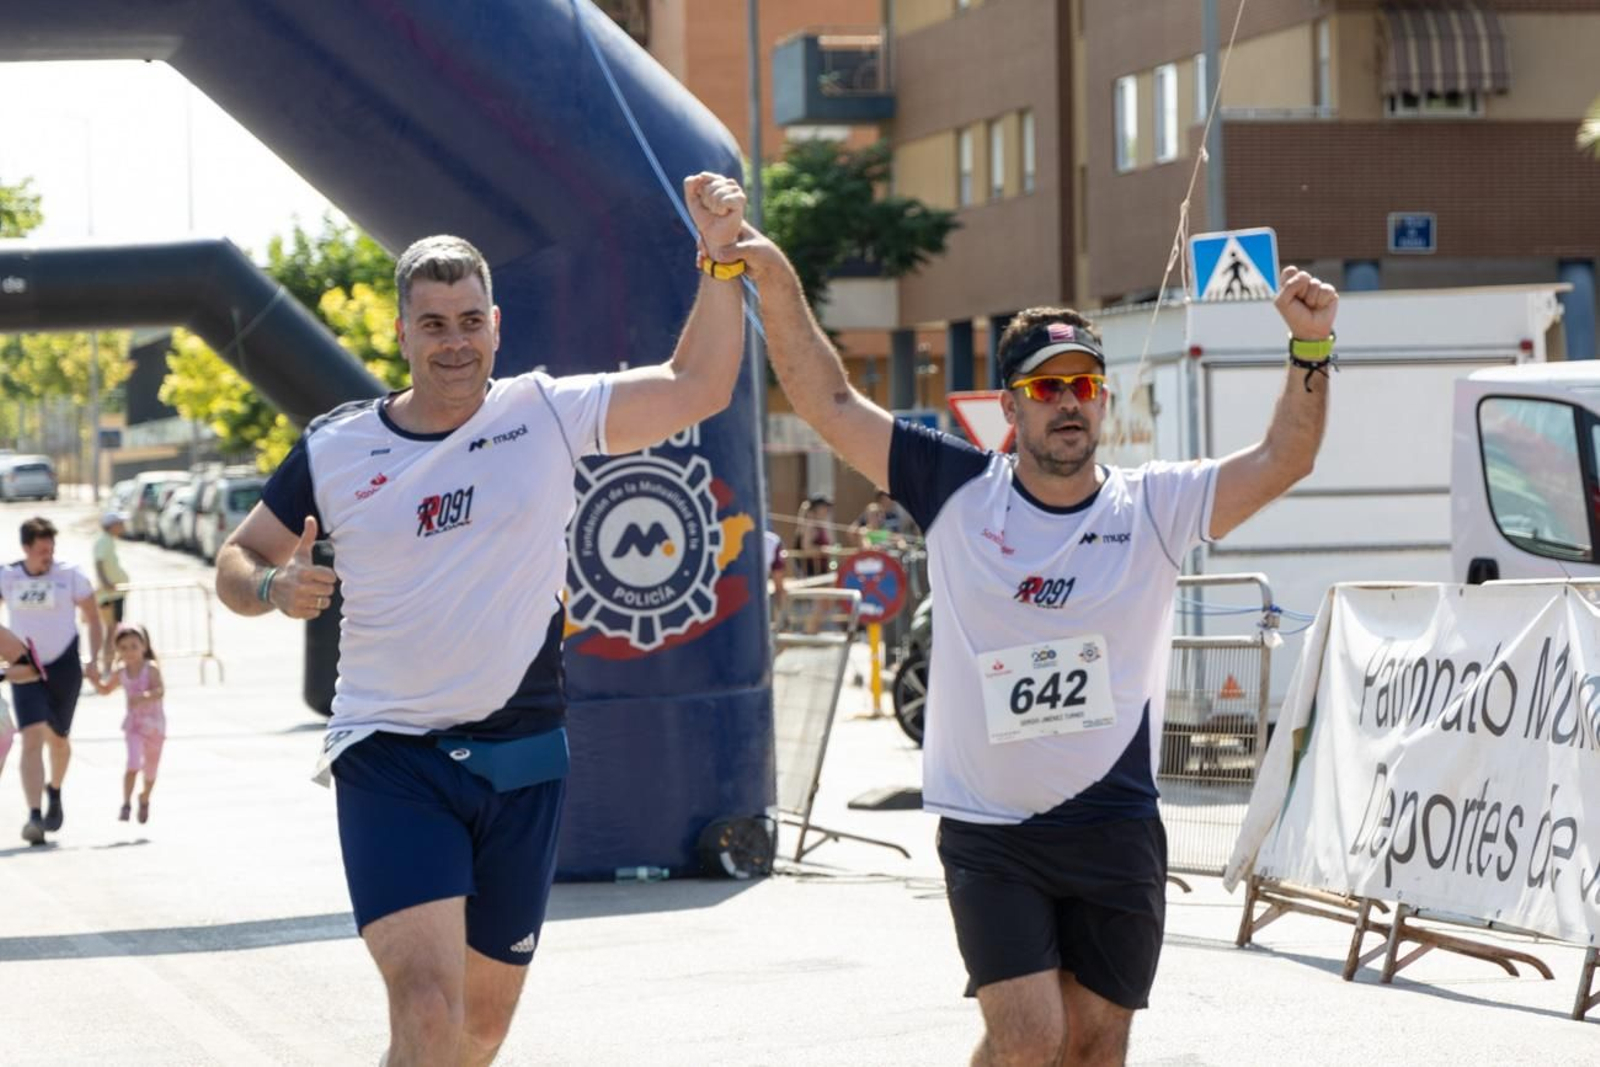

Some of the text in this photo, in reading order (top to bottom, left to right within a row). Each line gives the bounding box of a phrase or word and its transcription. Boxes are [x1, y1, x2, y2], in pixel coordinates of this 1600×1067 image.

[493, 425, 528, 445] mupol
[609, 488, 623, 501] de
[624, 482, 637, 493] la
[613, 585, 676, 606] POLICÍA
[1010, 669, 1088, 715] 642
[1359, 637, 1518, 738] Patronato
[1349, 763, 1577, 893] Deportes de
